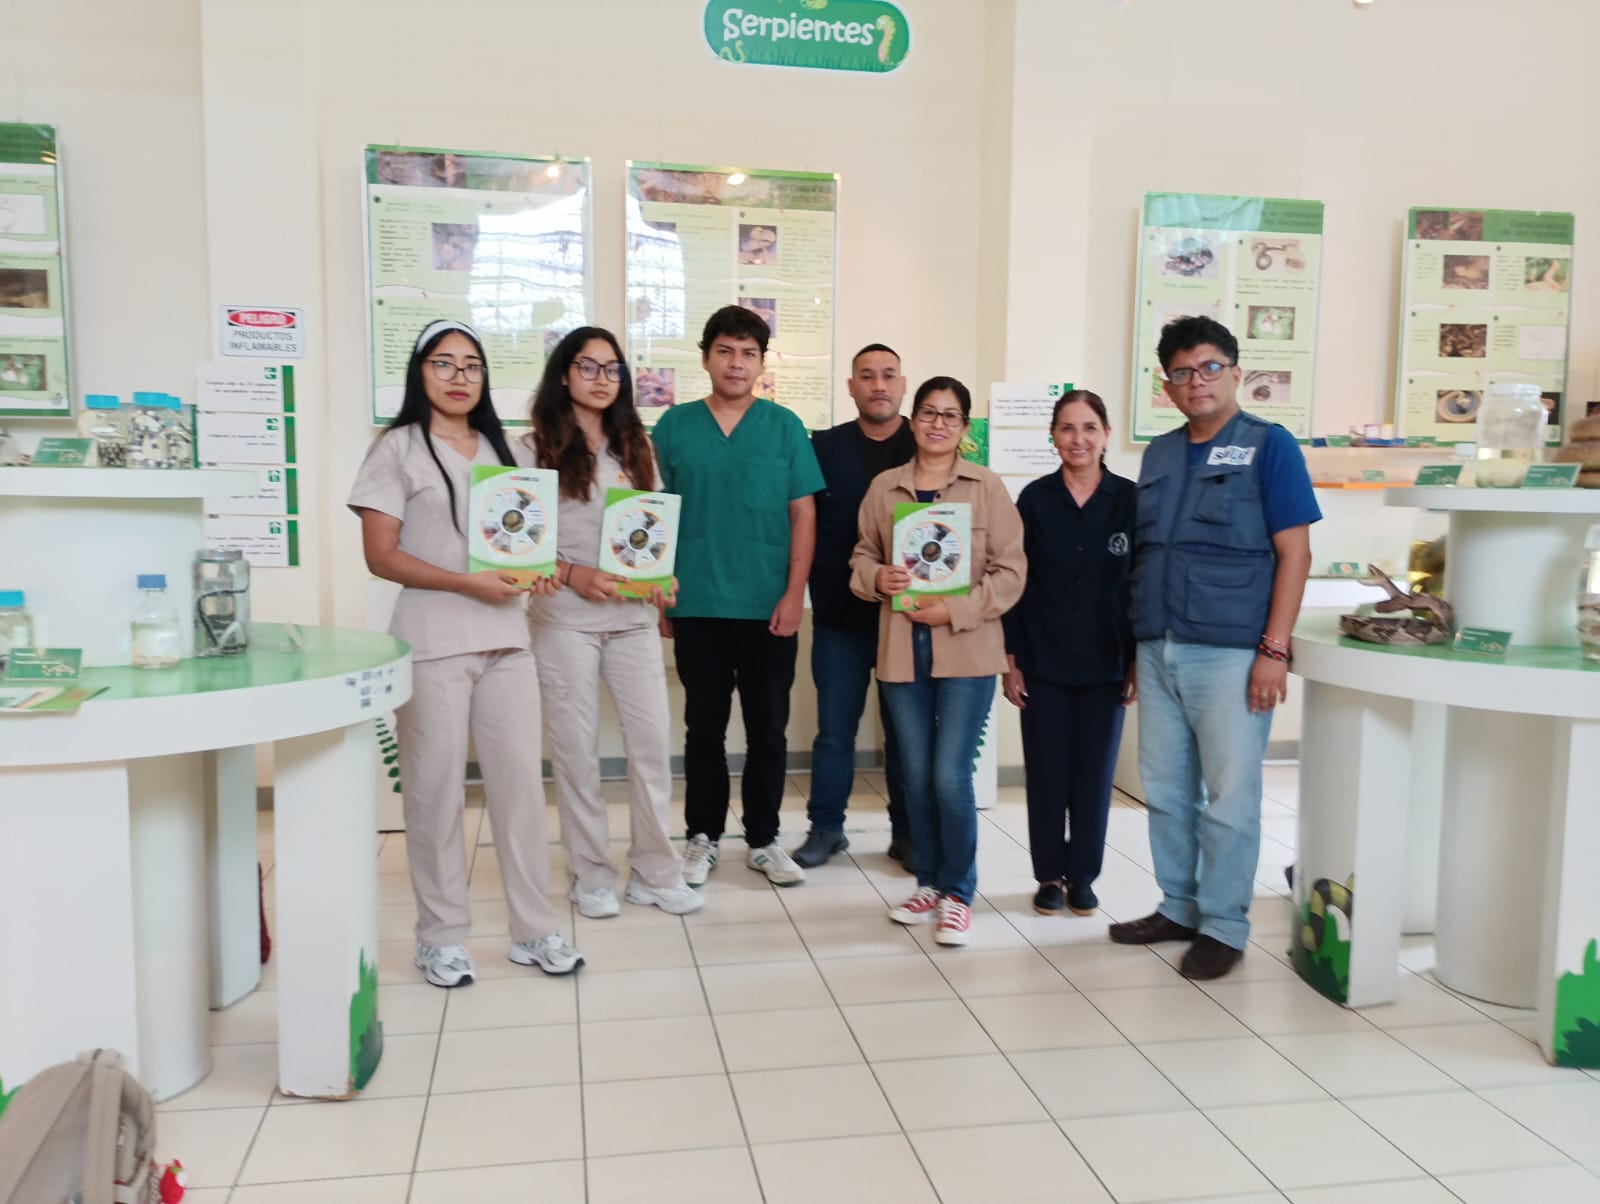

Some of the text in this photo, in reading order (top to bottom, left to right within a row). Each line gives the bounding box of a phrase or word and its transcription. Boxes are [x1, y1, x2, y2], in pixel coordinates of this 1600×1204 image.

[722, 8, 875, 46] Serpientes
[233, 330, 293, 341] PRODUCTOS
[230, 341, 297, 352] INFLAMABLES
